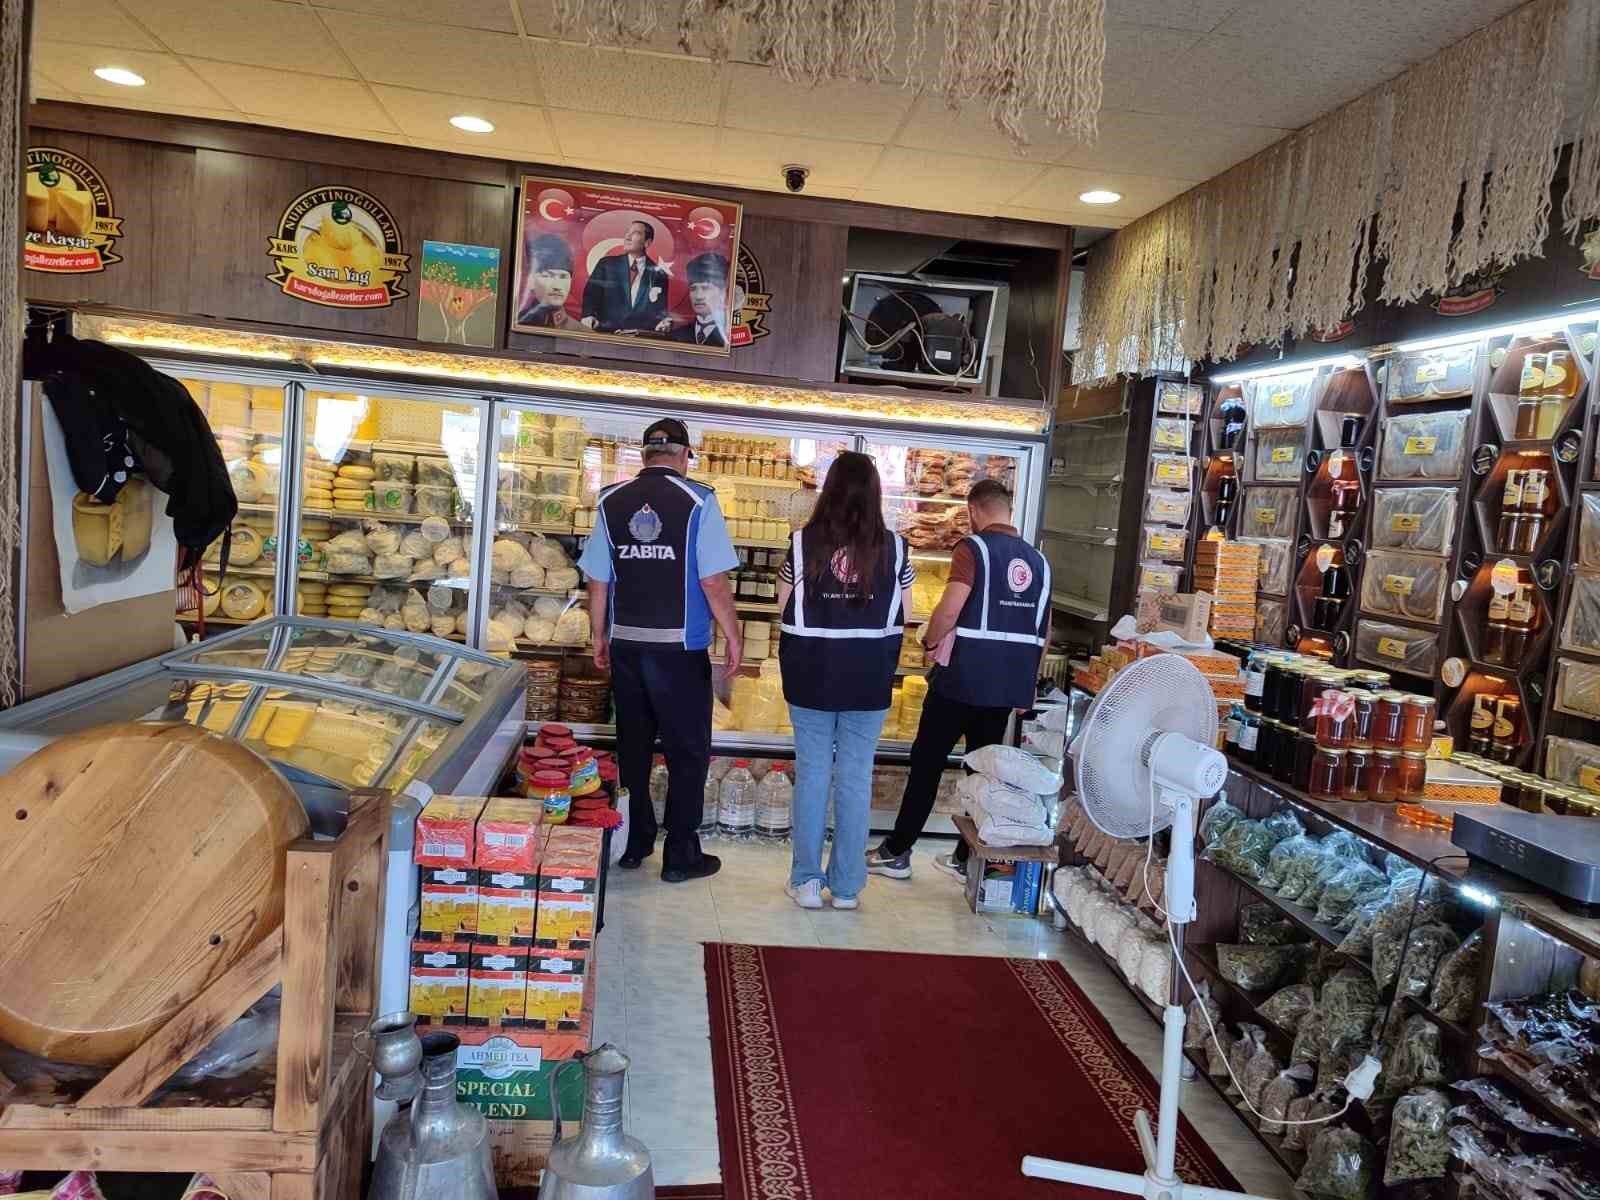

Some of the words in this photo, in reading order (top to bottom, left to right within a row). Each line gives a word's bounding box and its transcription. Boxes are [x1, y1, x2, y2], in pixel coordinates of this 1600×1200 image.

[25, 231, 41, 241] ze
[276, 243, 298, 254] KARS
[617, 545, 677, 560] ZABITA
[456, 1080, 536, 1098] SPECIAL
